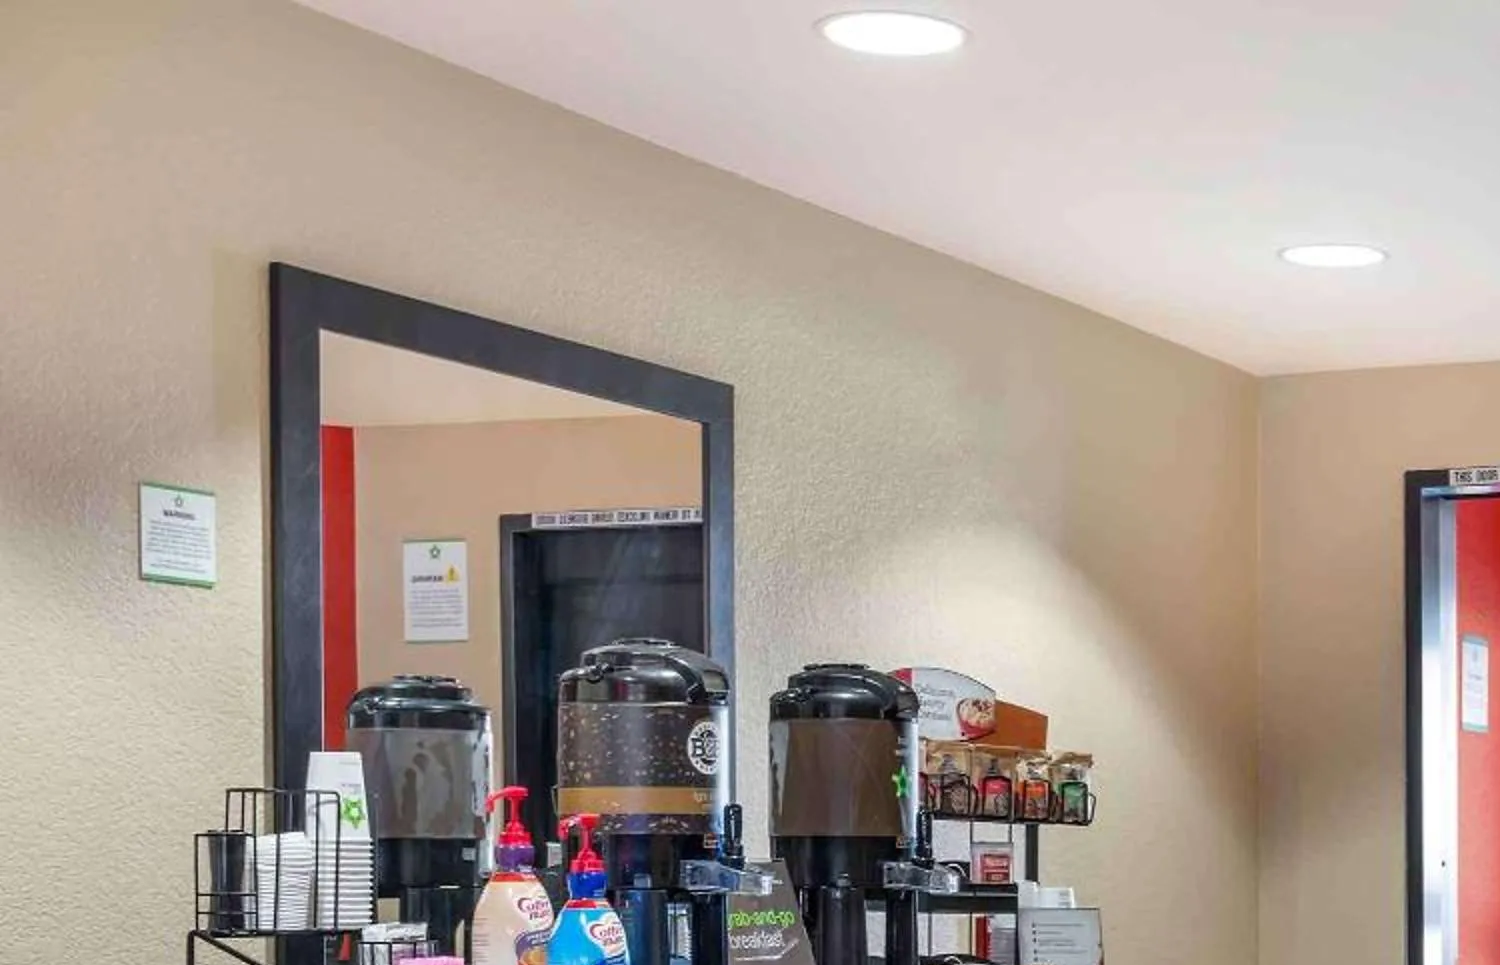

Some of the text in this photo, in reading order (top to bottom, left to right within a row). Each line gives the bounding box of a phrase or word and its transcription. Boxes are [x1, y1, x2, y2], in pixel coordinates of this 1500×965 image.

[1455, 471, 1474, 483] THIS
[1476, 469, 1499, 481] DOOR
[728, 910, 795, 929] rab-and-go
